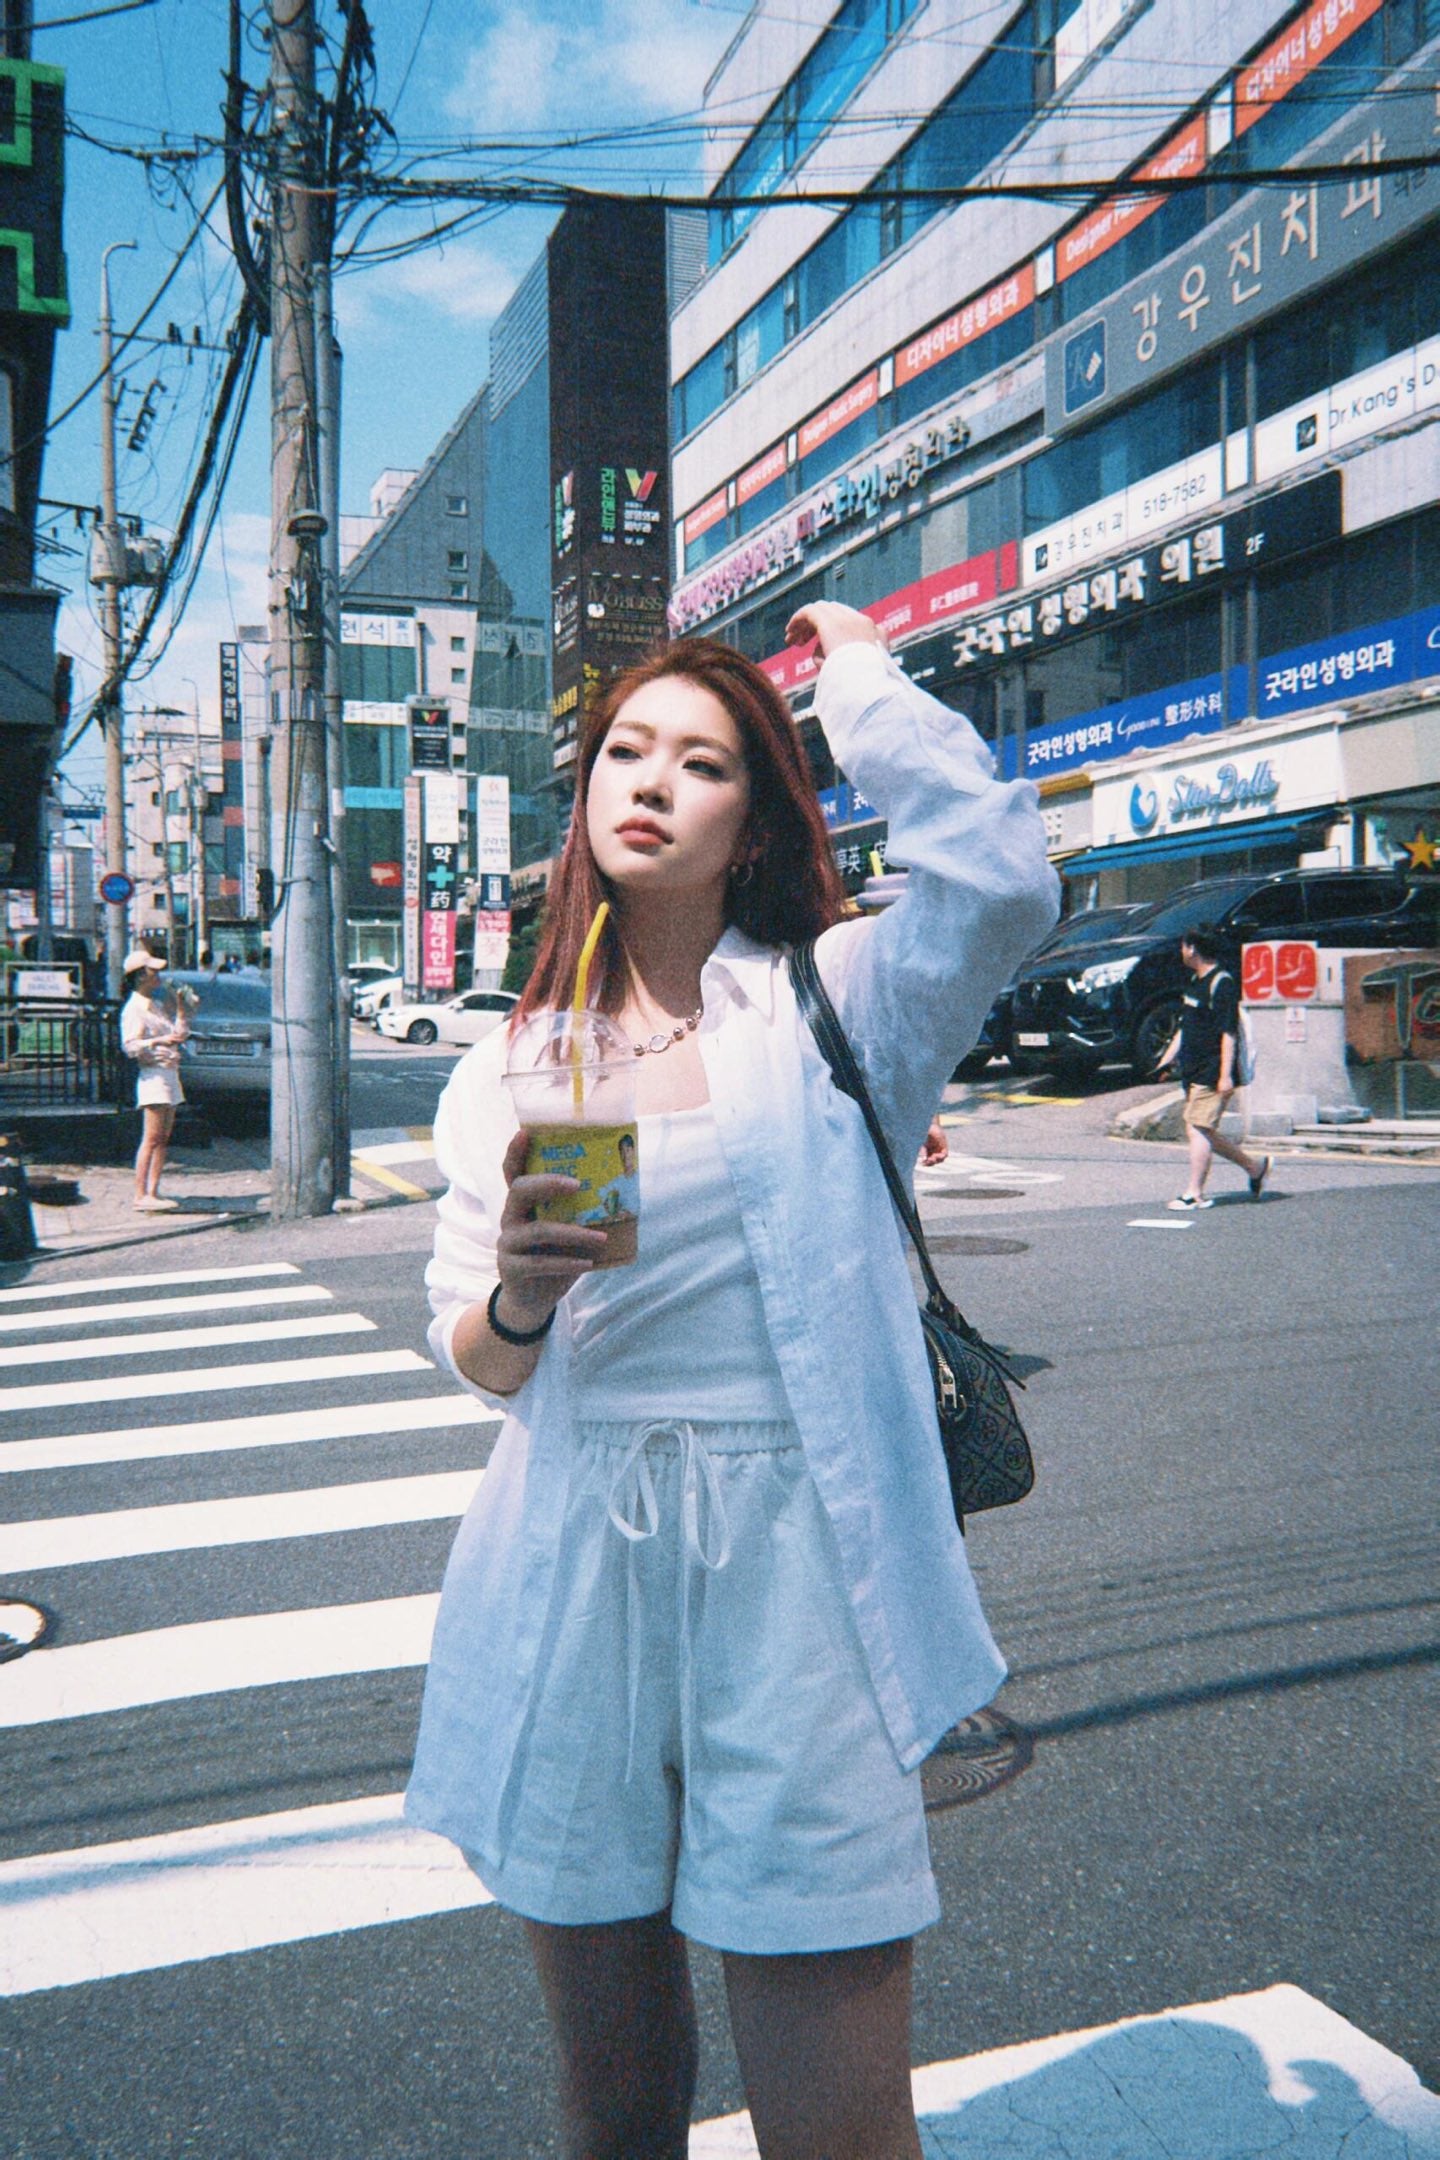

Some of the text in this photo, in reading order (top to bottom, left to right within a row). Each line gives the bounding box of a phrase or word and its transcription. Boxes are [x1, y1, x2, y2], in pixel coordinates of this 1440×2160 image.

[1133, 127, 1387, 363] 강우진치과
[1160, 524, 1225, 583] 의원
[1245, 532, 1265, 557] 2F
[1264, 638, 1396, 701] 굿라인성형외과
[1027, 720, 1114, 766] 굿라인성형외과
[432, 844, 453, 864] 약
